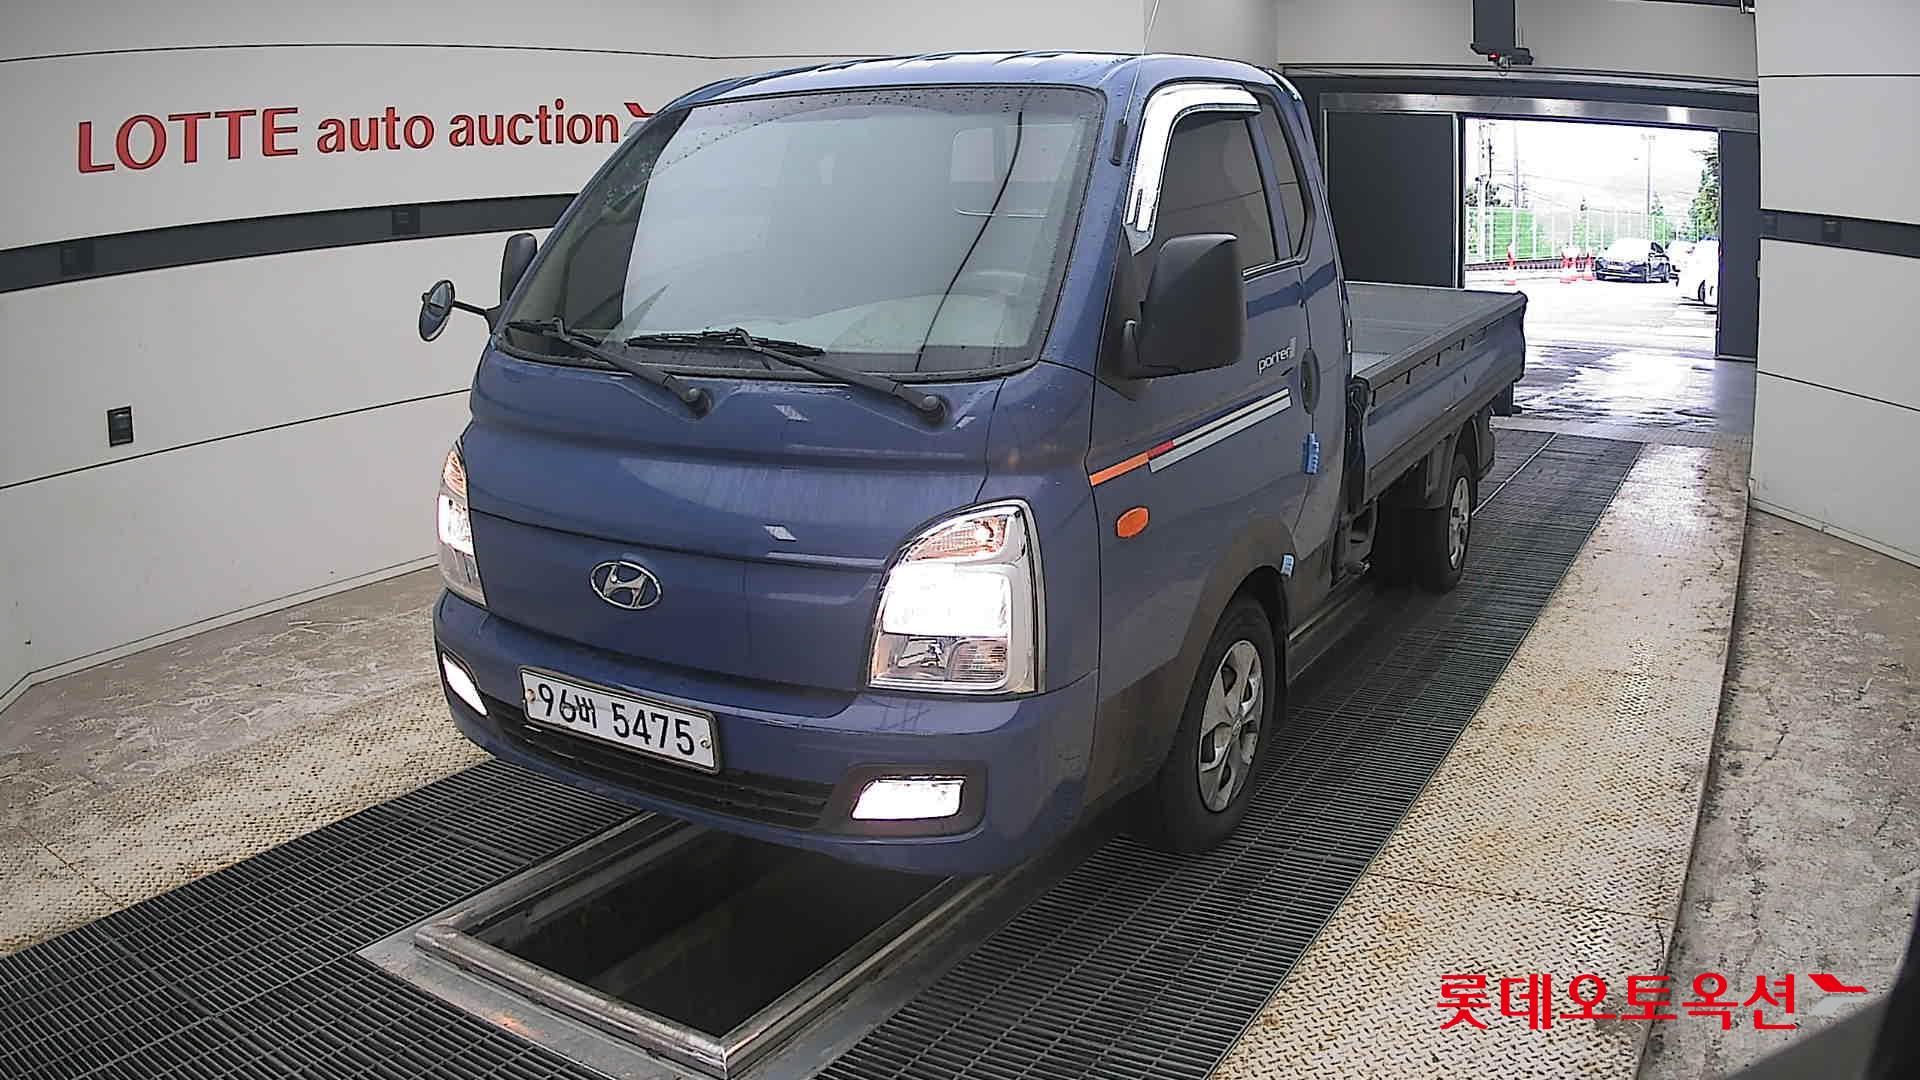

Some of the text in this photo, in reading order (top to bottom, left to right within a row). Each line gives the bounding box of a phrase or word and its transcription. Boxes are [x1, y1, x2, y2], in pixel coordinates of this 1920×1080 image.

[78, 98, 620, 174] LOTTE auto auction
[538, 683, 695, 755] 96버 5475
